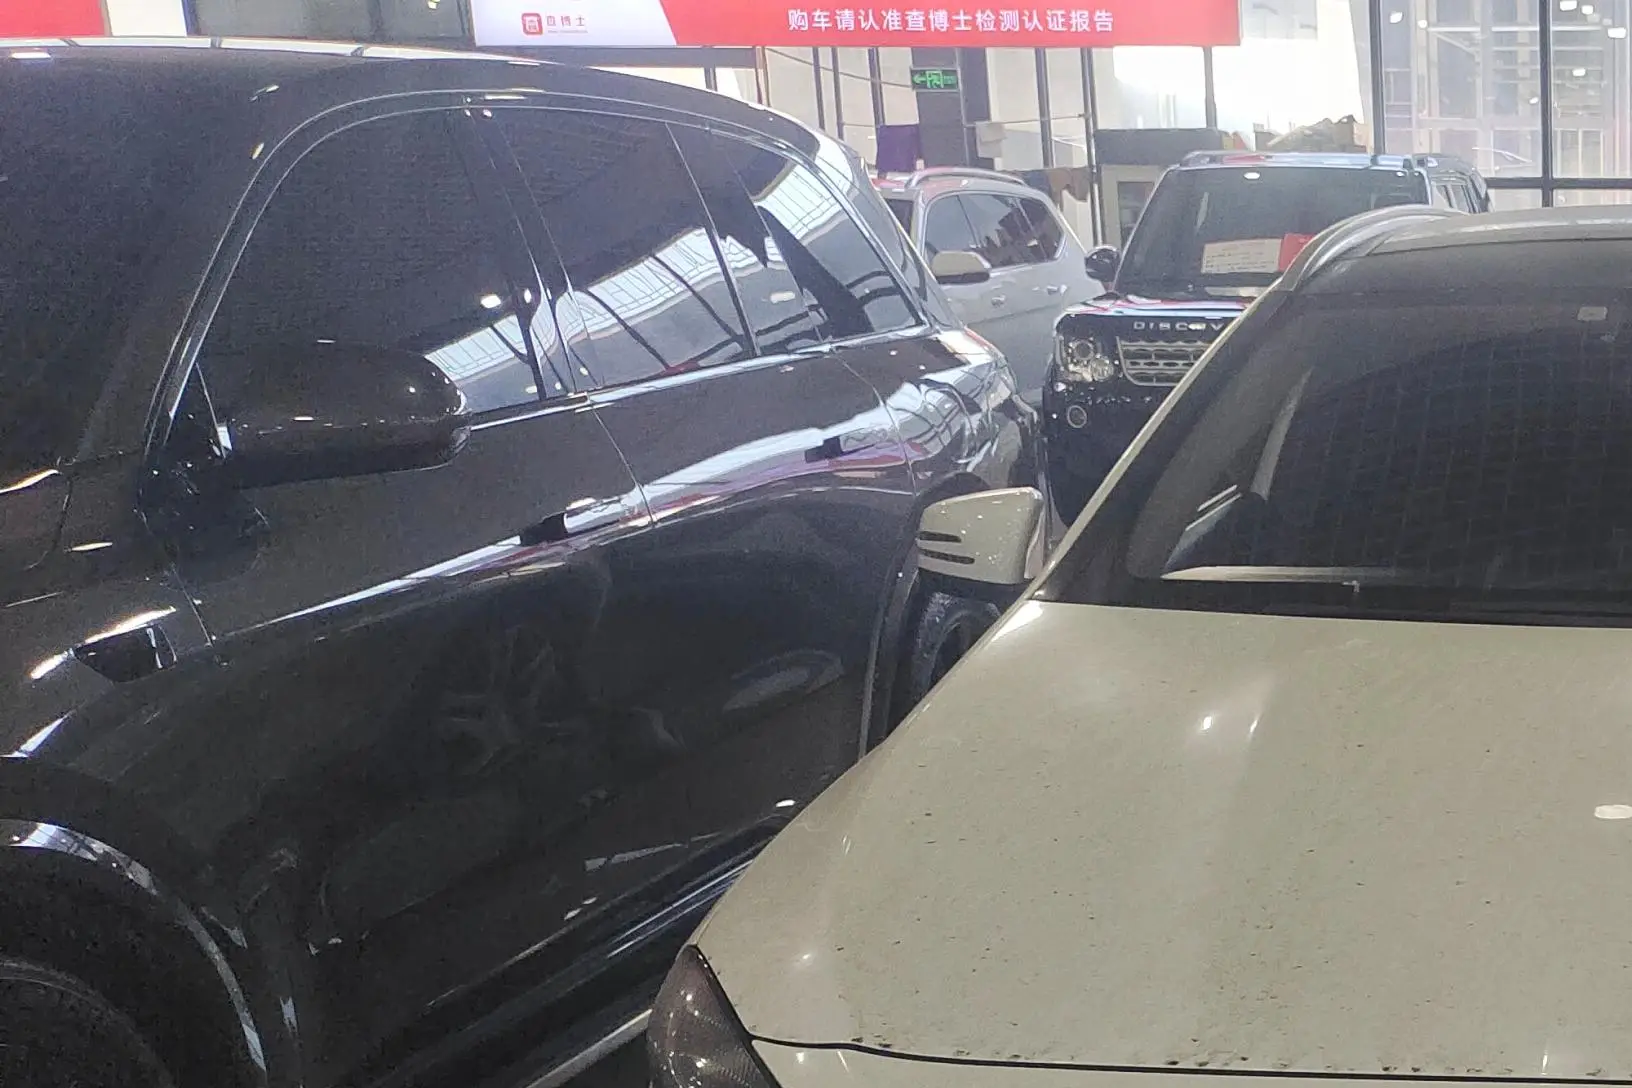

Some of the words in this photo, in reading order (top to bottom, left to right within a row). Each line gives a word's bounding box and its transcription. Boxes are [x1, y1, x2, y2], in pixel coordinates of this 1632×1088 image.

[788, 9, 1114, 32] 购车请认准查博士检测认证报告
[1133, 321, 1224, 331] DISCOV
